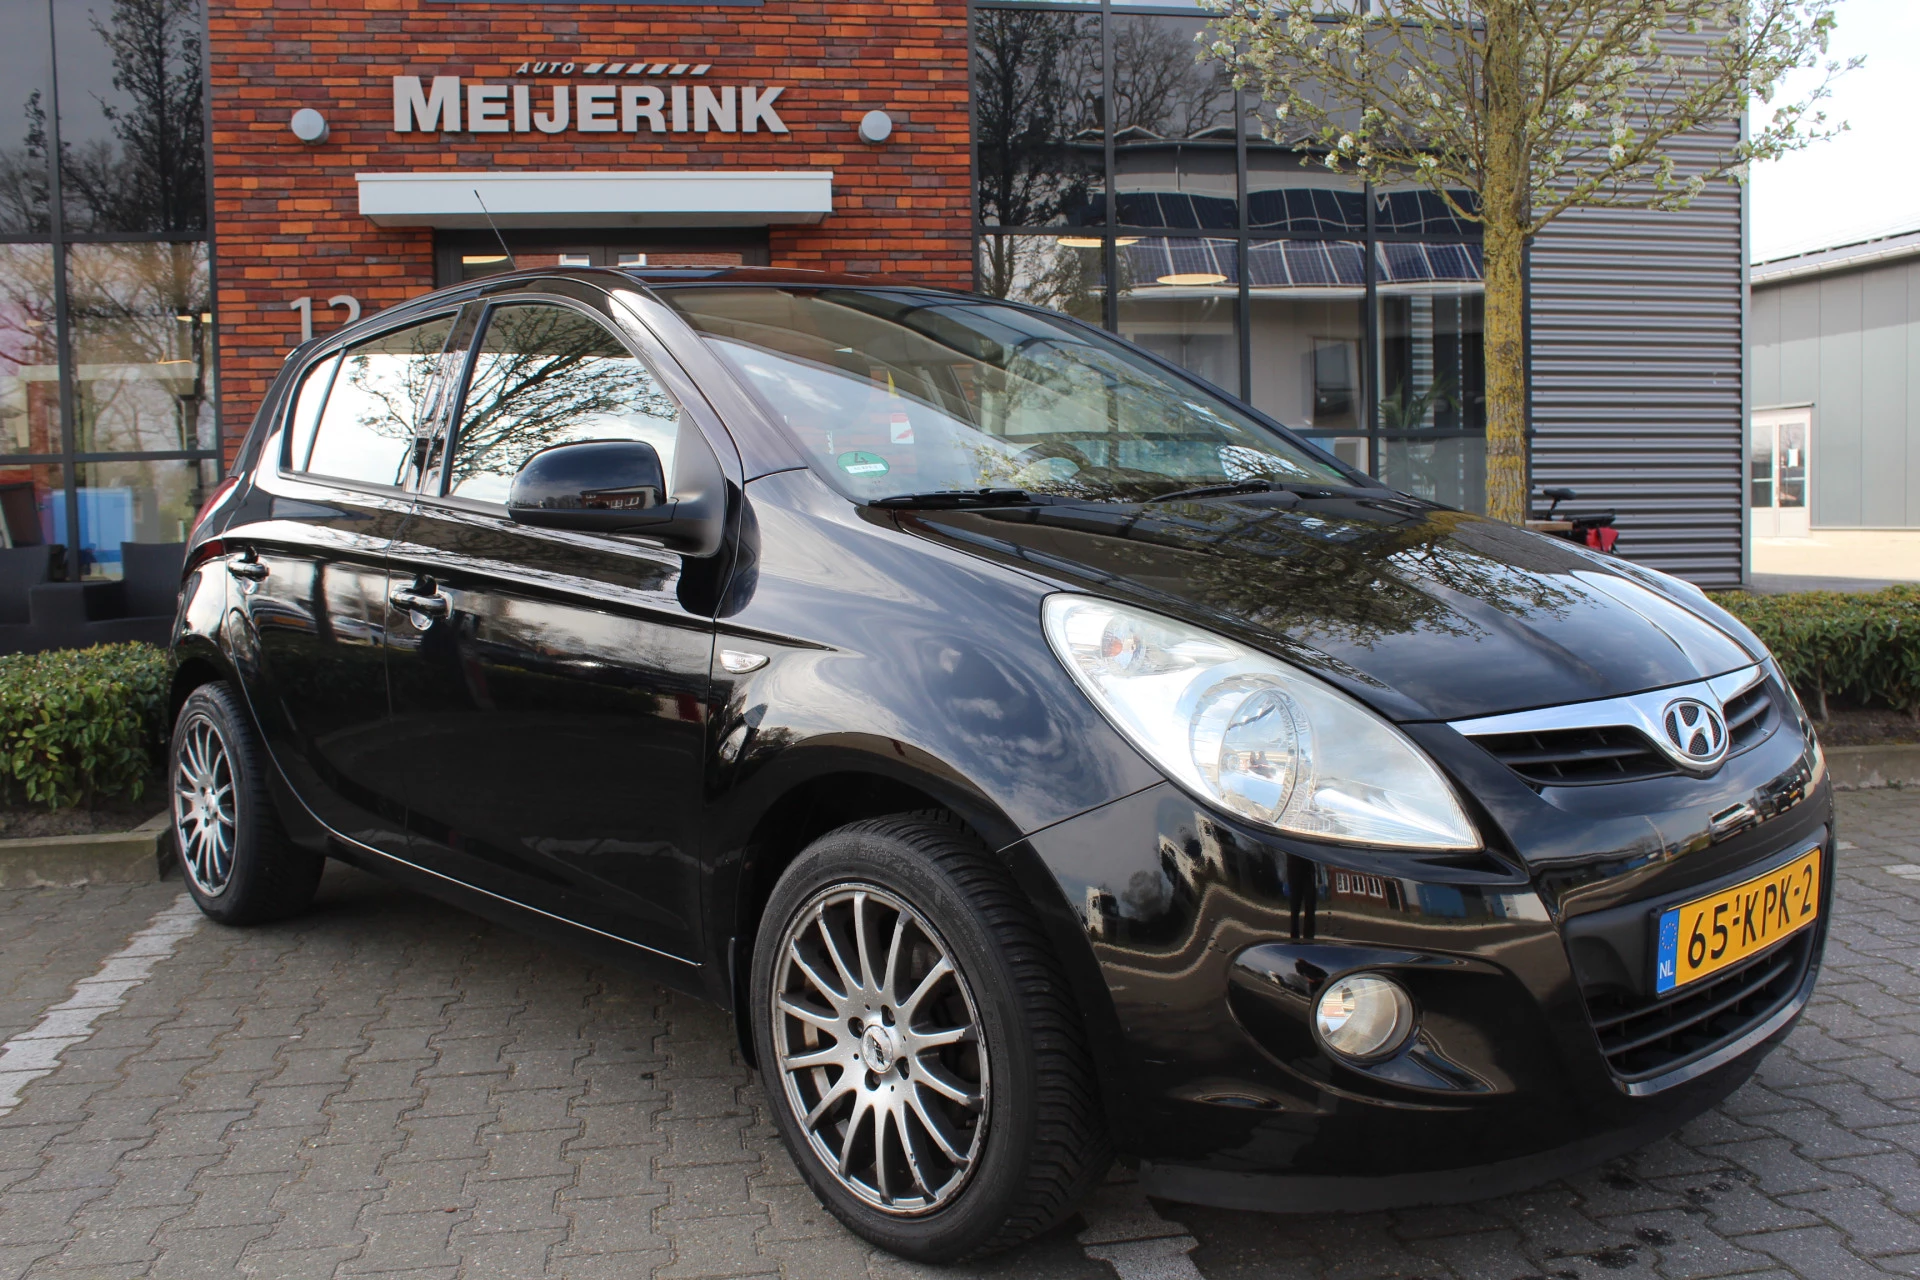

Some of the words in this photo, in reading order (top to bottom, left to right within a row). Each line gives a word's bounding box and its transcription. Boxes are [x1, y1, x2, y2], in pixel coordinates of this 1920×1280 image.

[515, 61, 576, 75] AUTO
[393, 75, 790, 134] MEIJERINK
[289, 294, 361, 342] 12
[1658, 959, 1674, 980] NL
